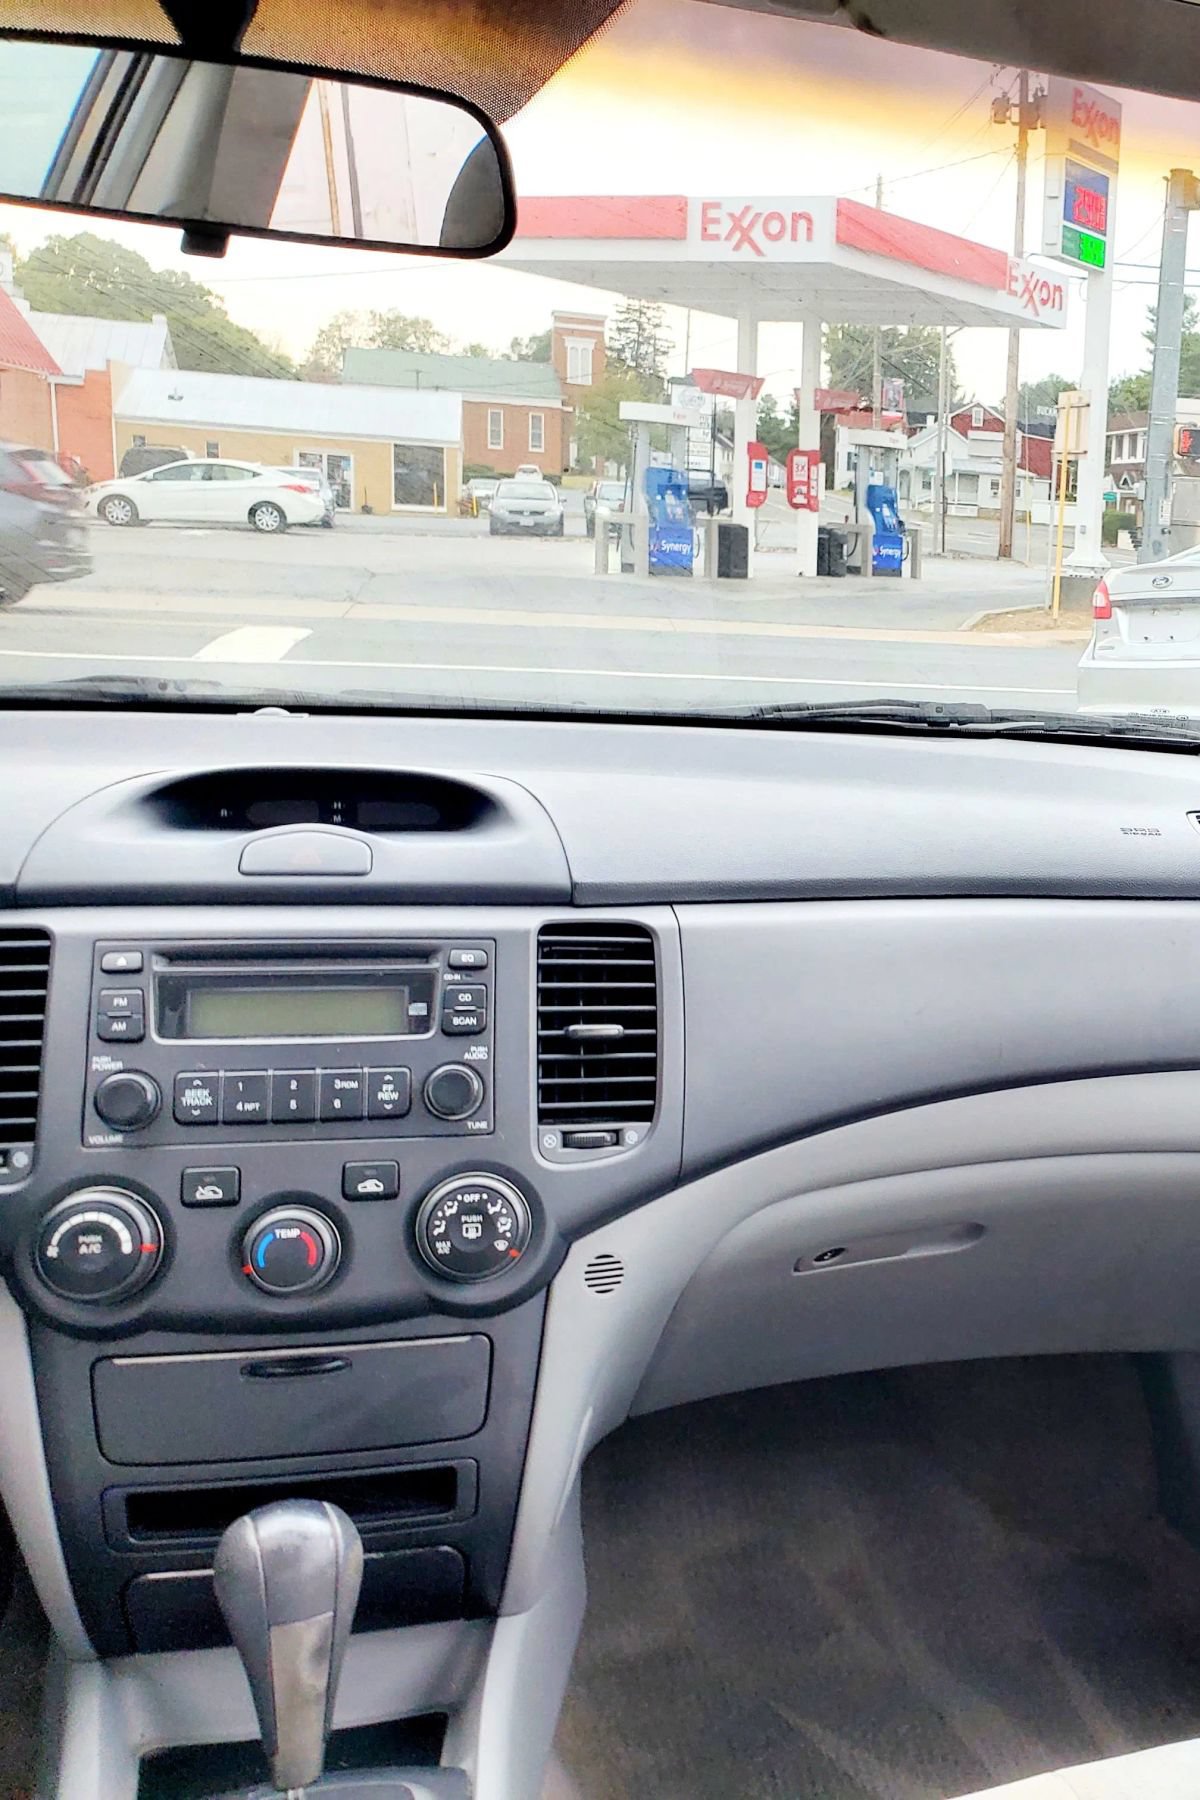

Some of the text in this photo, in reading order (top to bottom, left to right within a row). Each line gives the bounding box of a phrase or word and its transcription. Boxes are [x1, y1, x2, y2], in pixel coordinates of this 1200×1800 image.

[701, 202, 813, 257] Exxon
[1007, 262, 1063, 316] Exxon
[661, 540, 691, 555] Synergy
[113, 997, 128, 1007] FM
[458, 993, 472, 1002] CD
[452, 1016, 477, 1026] SCAN
[111, 1021, 127, 1032] AM
[464, 1052, 488, 1060] AUDIO
[92, 1061, 123, 1071] POWER
[377, 1091, 399, 1101] REW
[181, 1096, 213, 1107] TRACK
[236, 1101, 243, 1112] 4
[467, 1121, 488, 1130] TUNE
[88, 1135, 124, 1145] VOLUME
[463, 1193, 480, 1203] OFF
[461, 1215, 483, 1223] PUSH
[274, 1228, 301, 1239] TEMP
[79, 1243, 102, 1255] A/C
